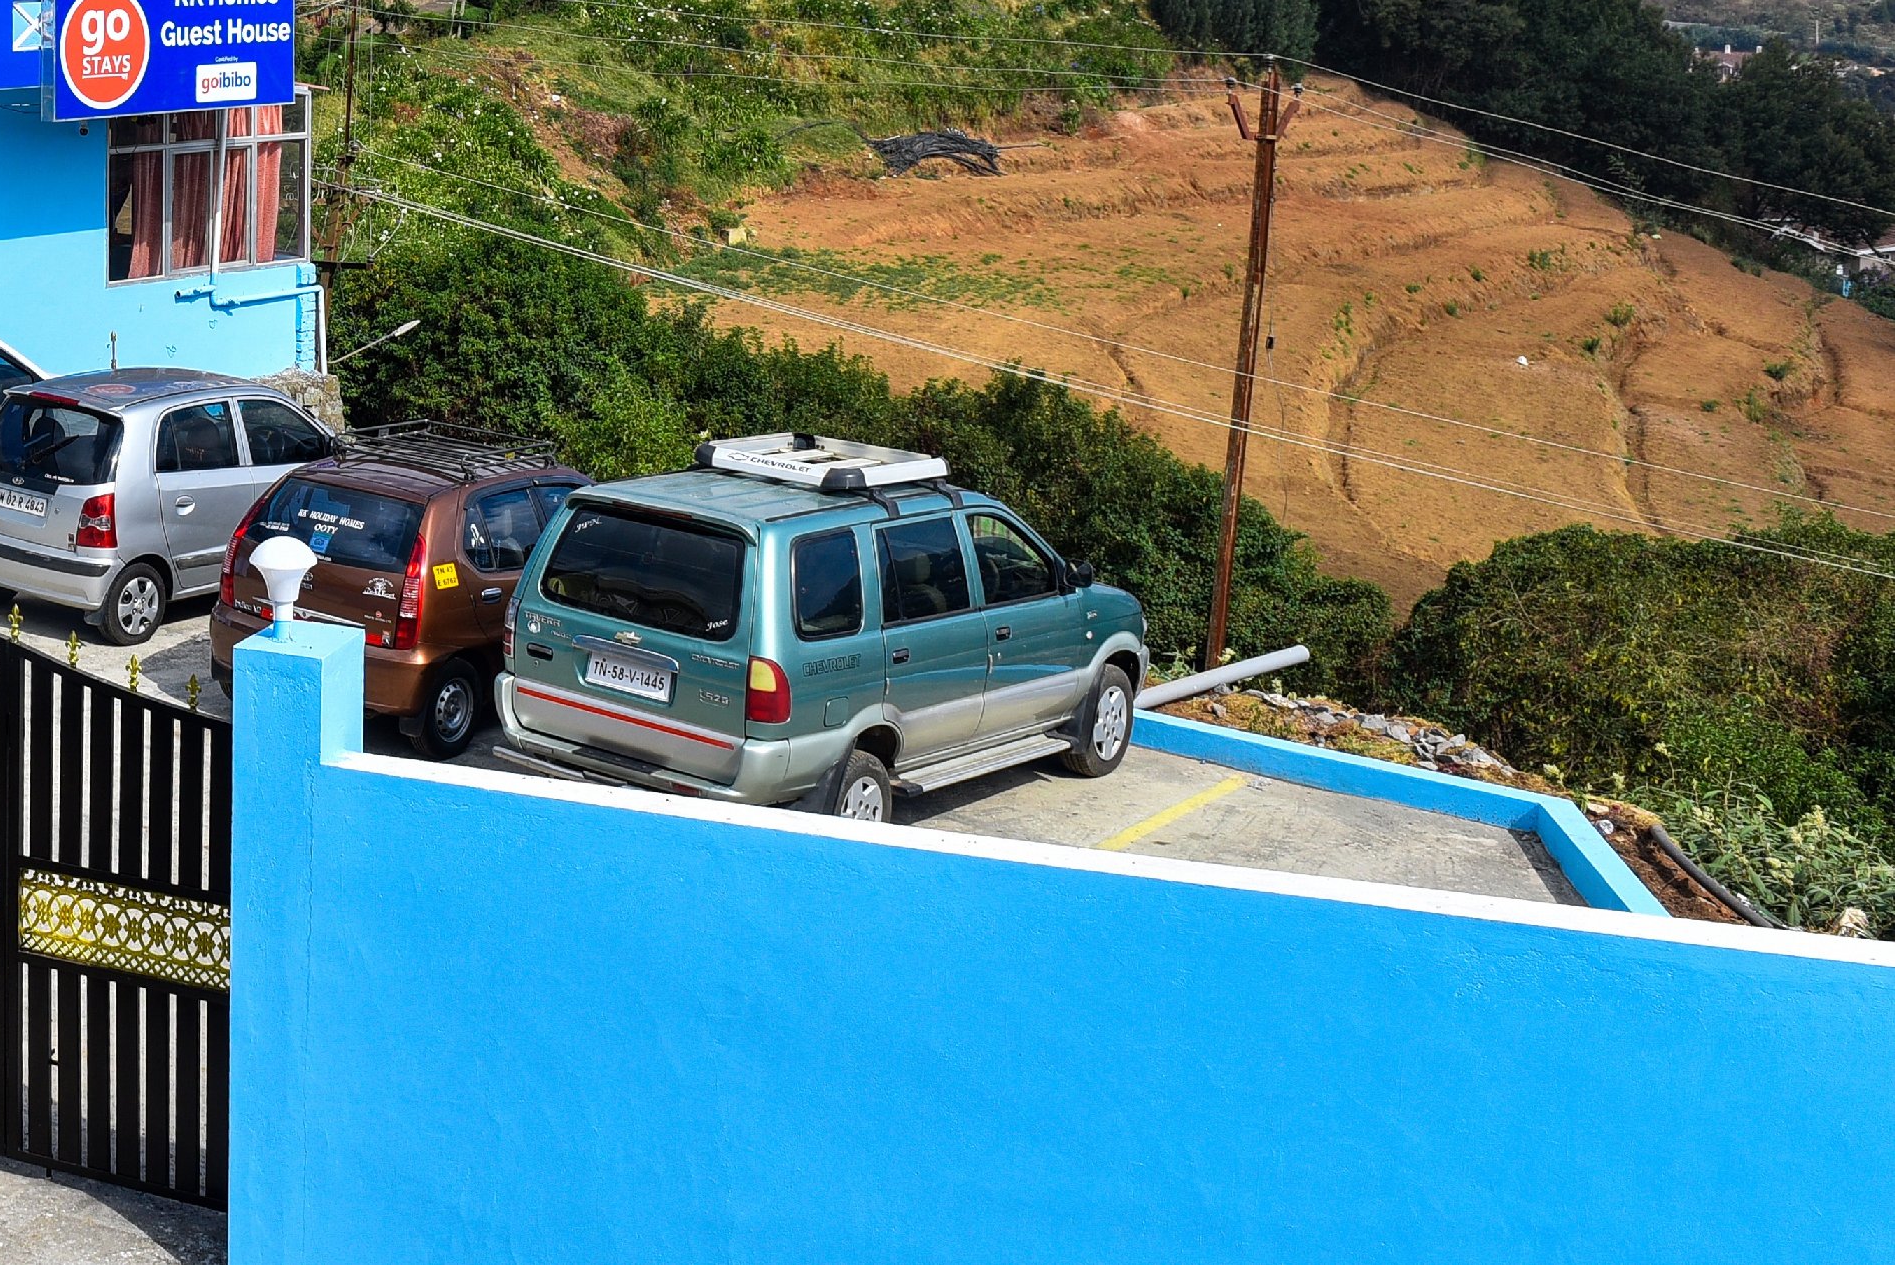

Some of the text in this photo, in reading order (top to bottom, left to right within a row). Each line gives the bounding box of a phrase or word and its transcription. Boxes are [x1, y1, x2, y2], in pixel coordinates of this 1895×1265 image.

[81, 8, 131, 55] go
[160, 18, 292, 47] Guest House
[82, 54, 131, 75] STAYS
[201, 71, 252, 94] goibibo
[750, 456, 812, 473] CHEVROLET
[6, 492, 17, 507] 02
[17, 497, 24, 509] R
[309, 510, 338, 524] HOLIDAY
[339, 517, 365, 530] HOMES
[314, 523, 339, 534] OOTY
[802, 653, 862, 677] CHEVROLET
